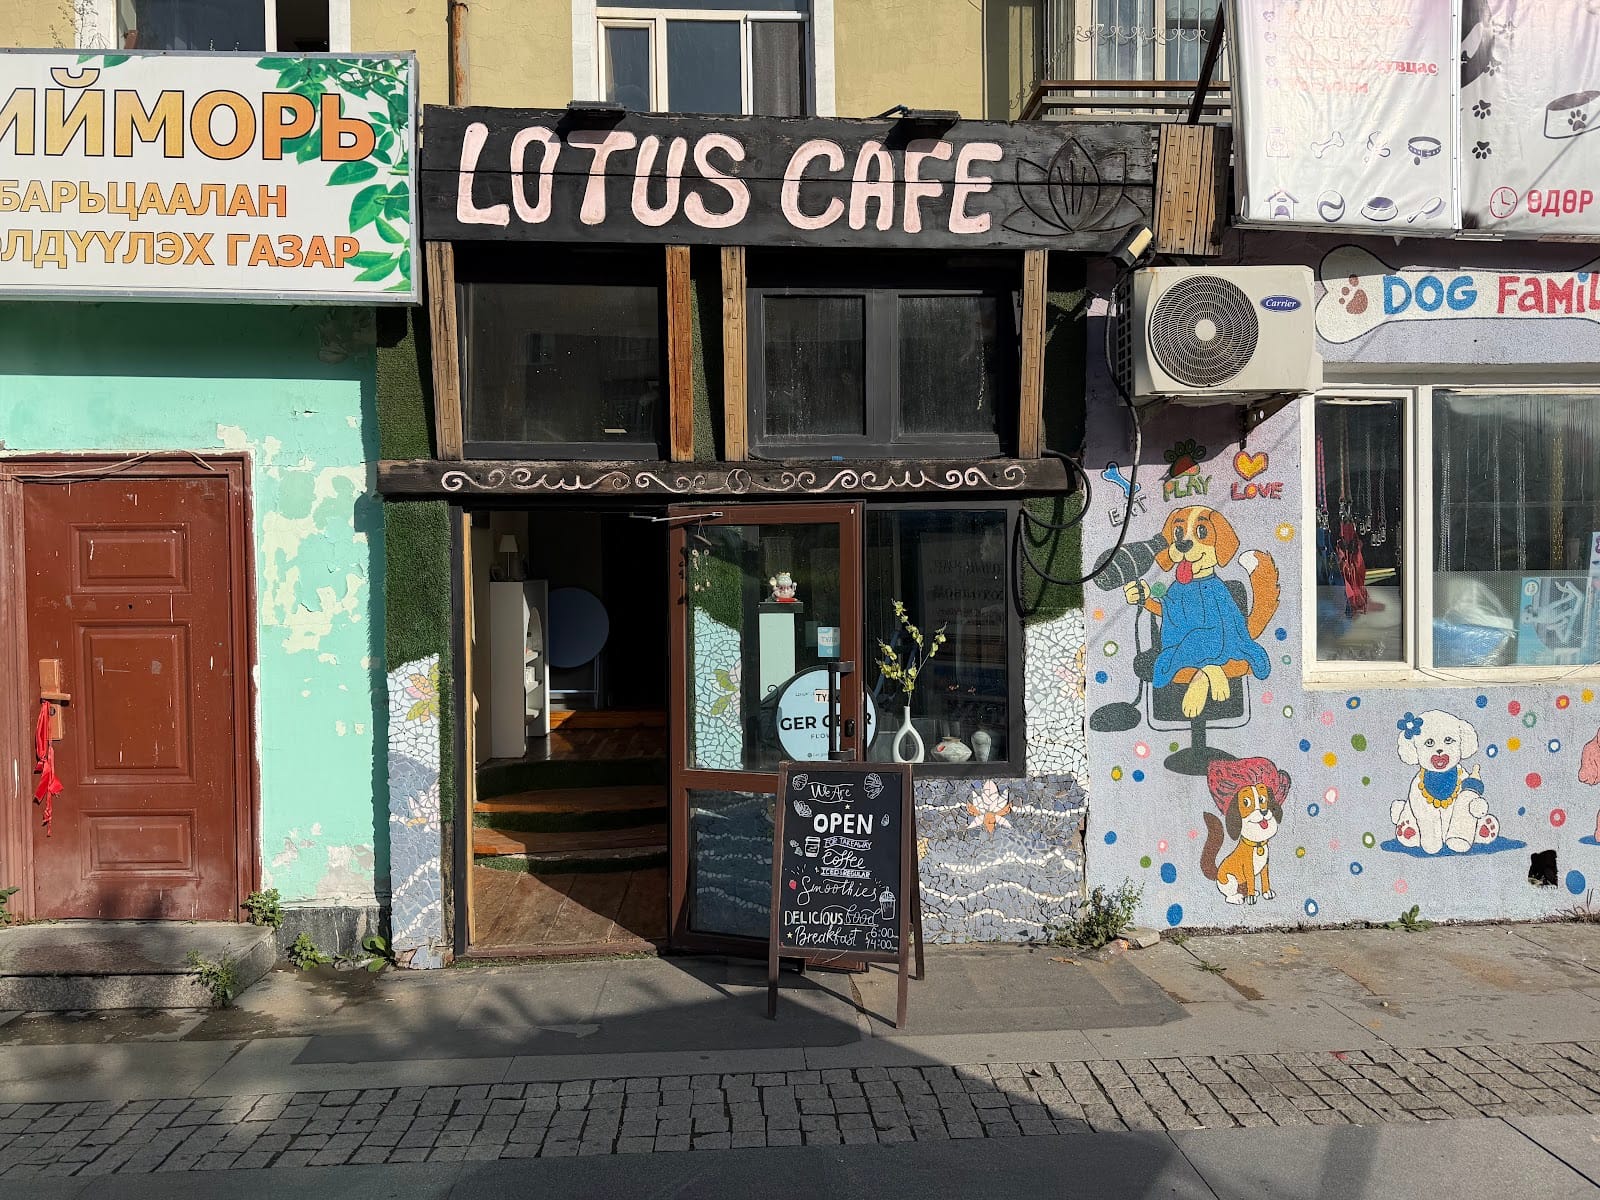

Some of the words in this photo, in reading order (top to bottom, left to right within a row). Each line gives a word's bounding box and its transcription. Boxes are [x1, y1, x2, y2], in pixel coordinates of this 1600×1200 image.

[457, 121, 752, 230] LOTUS
[780, 138, 1004, 234] CAFE
[1527, 189, 1594, 217] ӨДӨР
[0, 228, 214, 270] ЛДҮҮЛЭХ
[226, 233, 361, 269] ГАЗАР
[1265, 298, 1297, 308] Carrier
[1383, 275, 1478, 314] DOG
[1163, 474, 1212, 502] PLAY
[1231, 481, 1284, 500] LOVE
[780, 716, 817, 731] GER
[811, 785, 831, 798] We
[830, 786, 852, 800] Are
[813, 812, 874, 834] OPEN
[797, 876, 877, 905] Smoothies
[784, 910, 843, 926] DELICIOUS
[795, 925, 862, 946] Breakfast
